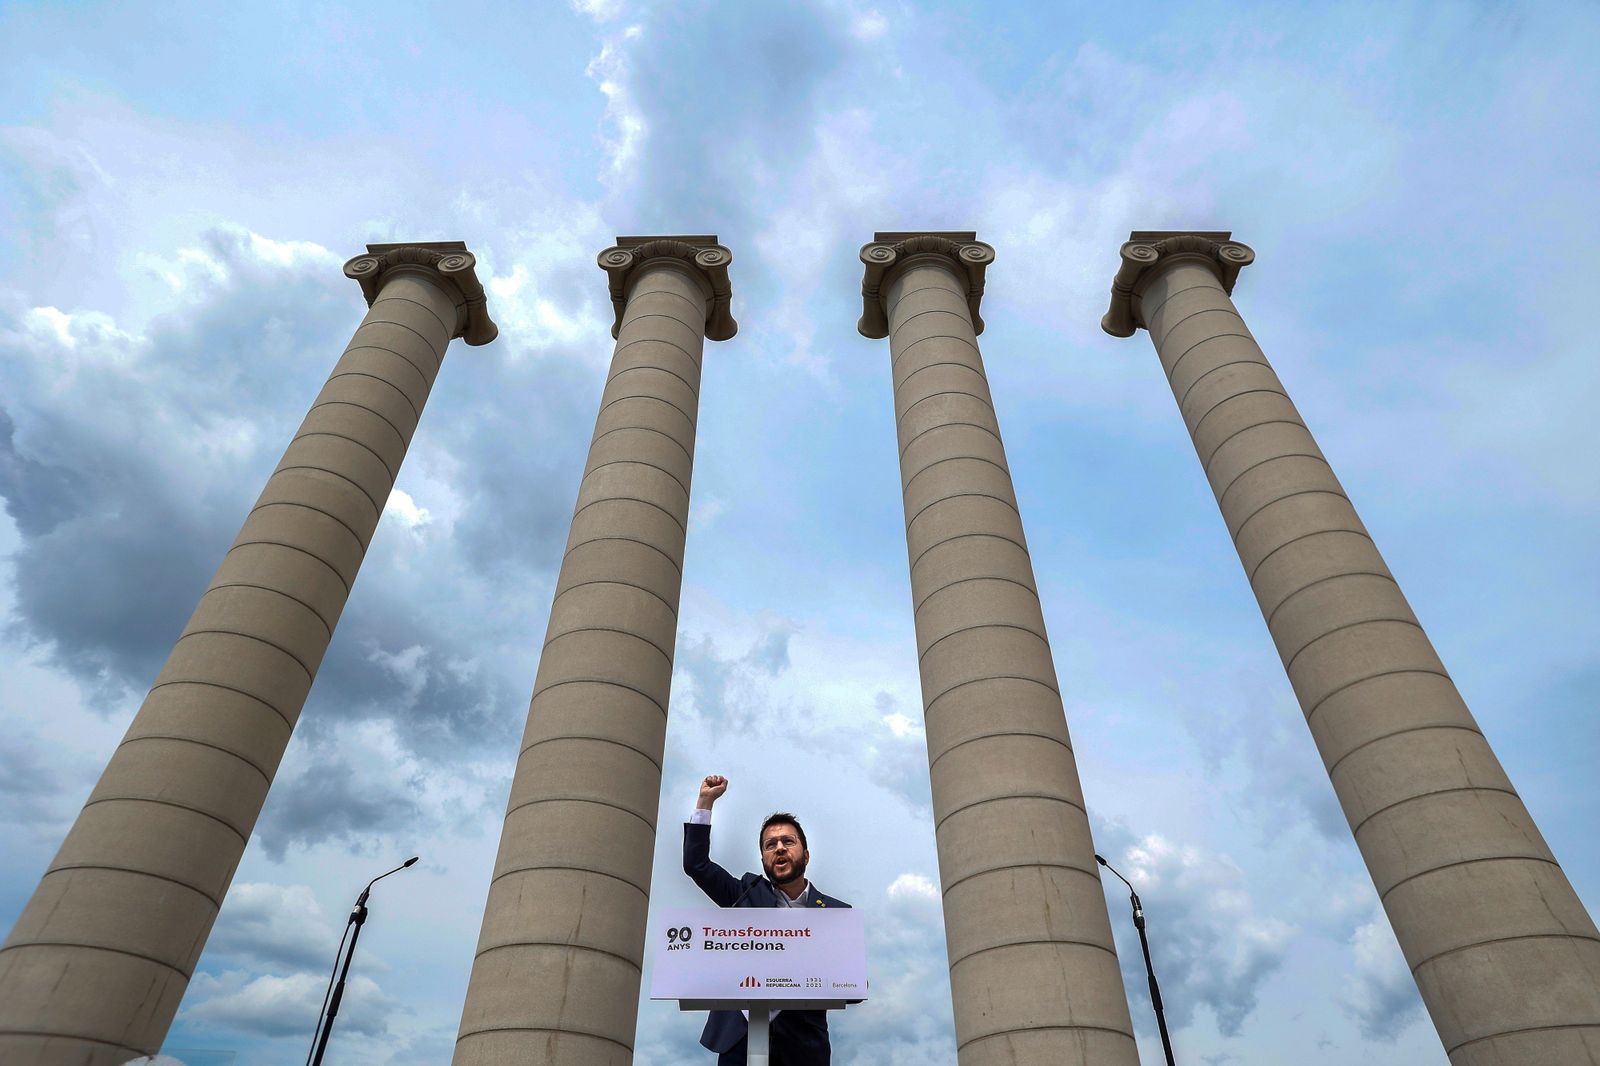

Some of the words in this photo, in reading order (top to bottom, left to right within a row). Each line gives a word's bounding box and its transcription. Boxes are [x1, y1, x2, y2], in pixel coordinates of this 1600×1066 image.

[667, 926, 693, 943] 90
[702, 926, 811, 938] Transformant
[667, 943, 691, 951] ANYS
[703, 940, 785, 951] Barcelona
